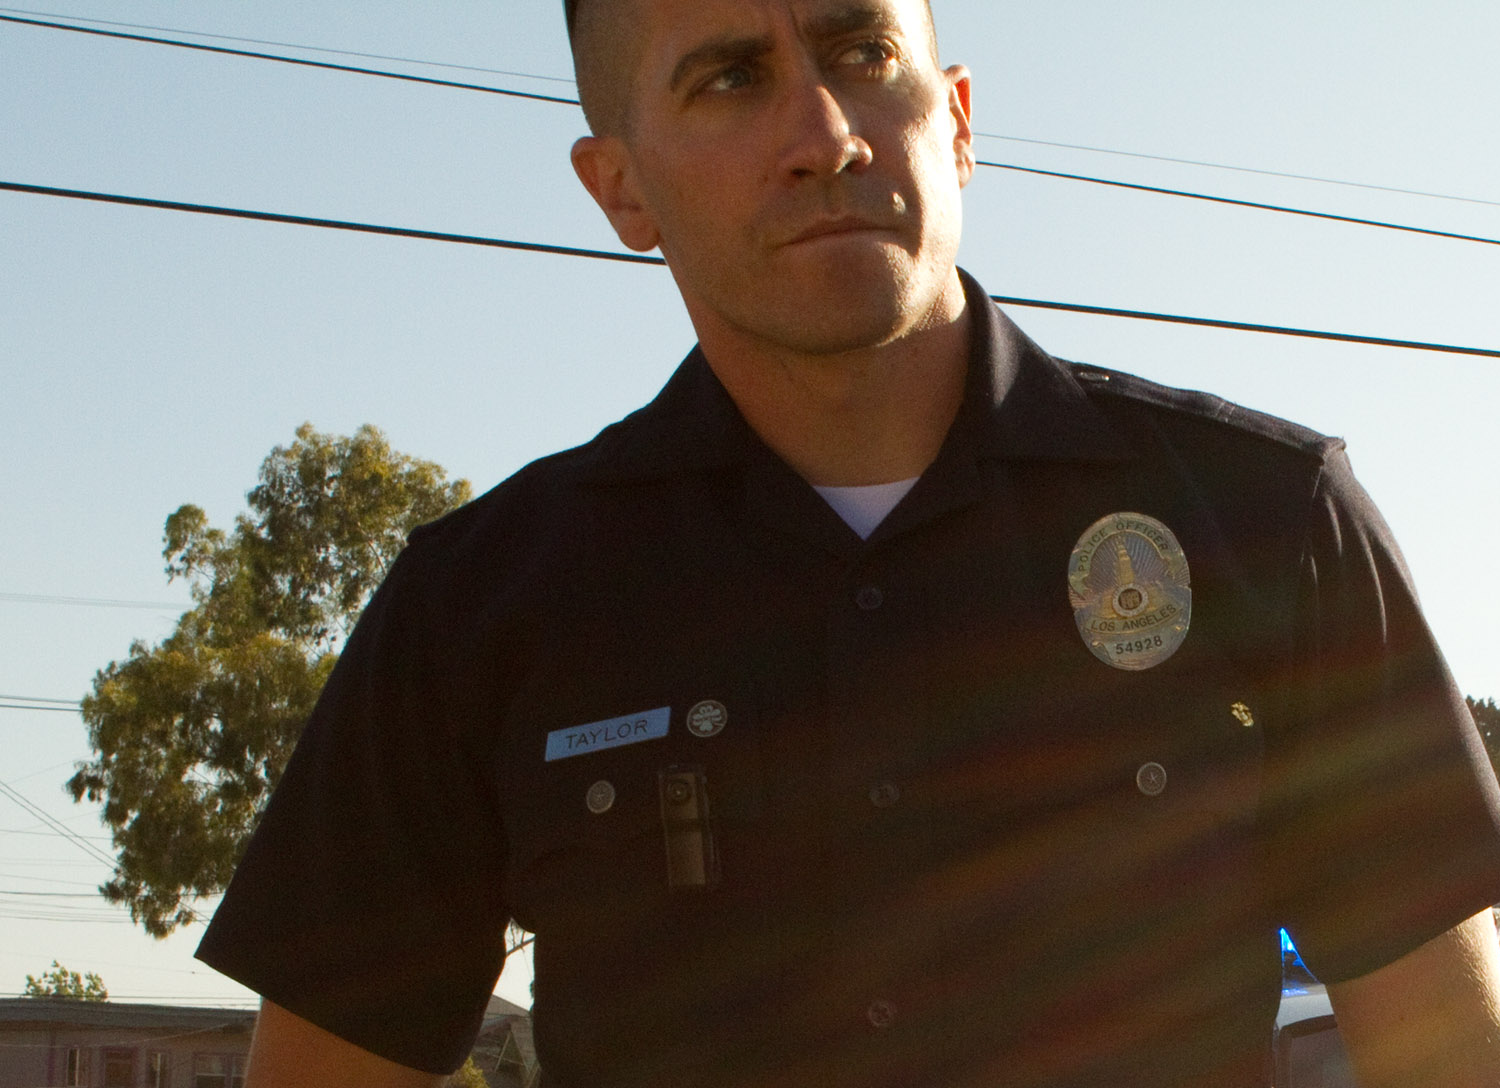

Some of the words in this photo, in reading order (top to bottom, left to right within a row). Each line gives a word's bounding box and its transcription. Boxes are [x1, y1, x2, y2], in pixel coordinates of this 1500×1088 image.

[1078, 527, 1109, 572] POLICE
[1116, 519, 1168, 551] OFFICER
[1091, 619, 1115, 631] LOS
[1122, 604, 1177, 631] ANGELES
[1115, 634, 1163, 655] 54928
[565, 719, 648, 749] TAYLOR
